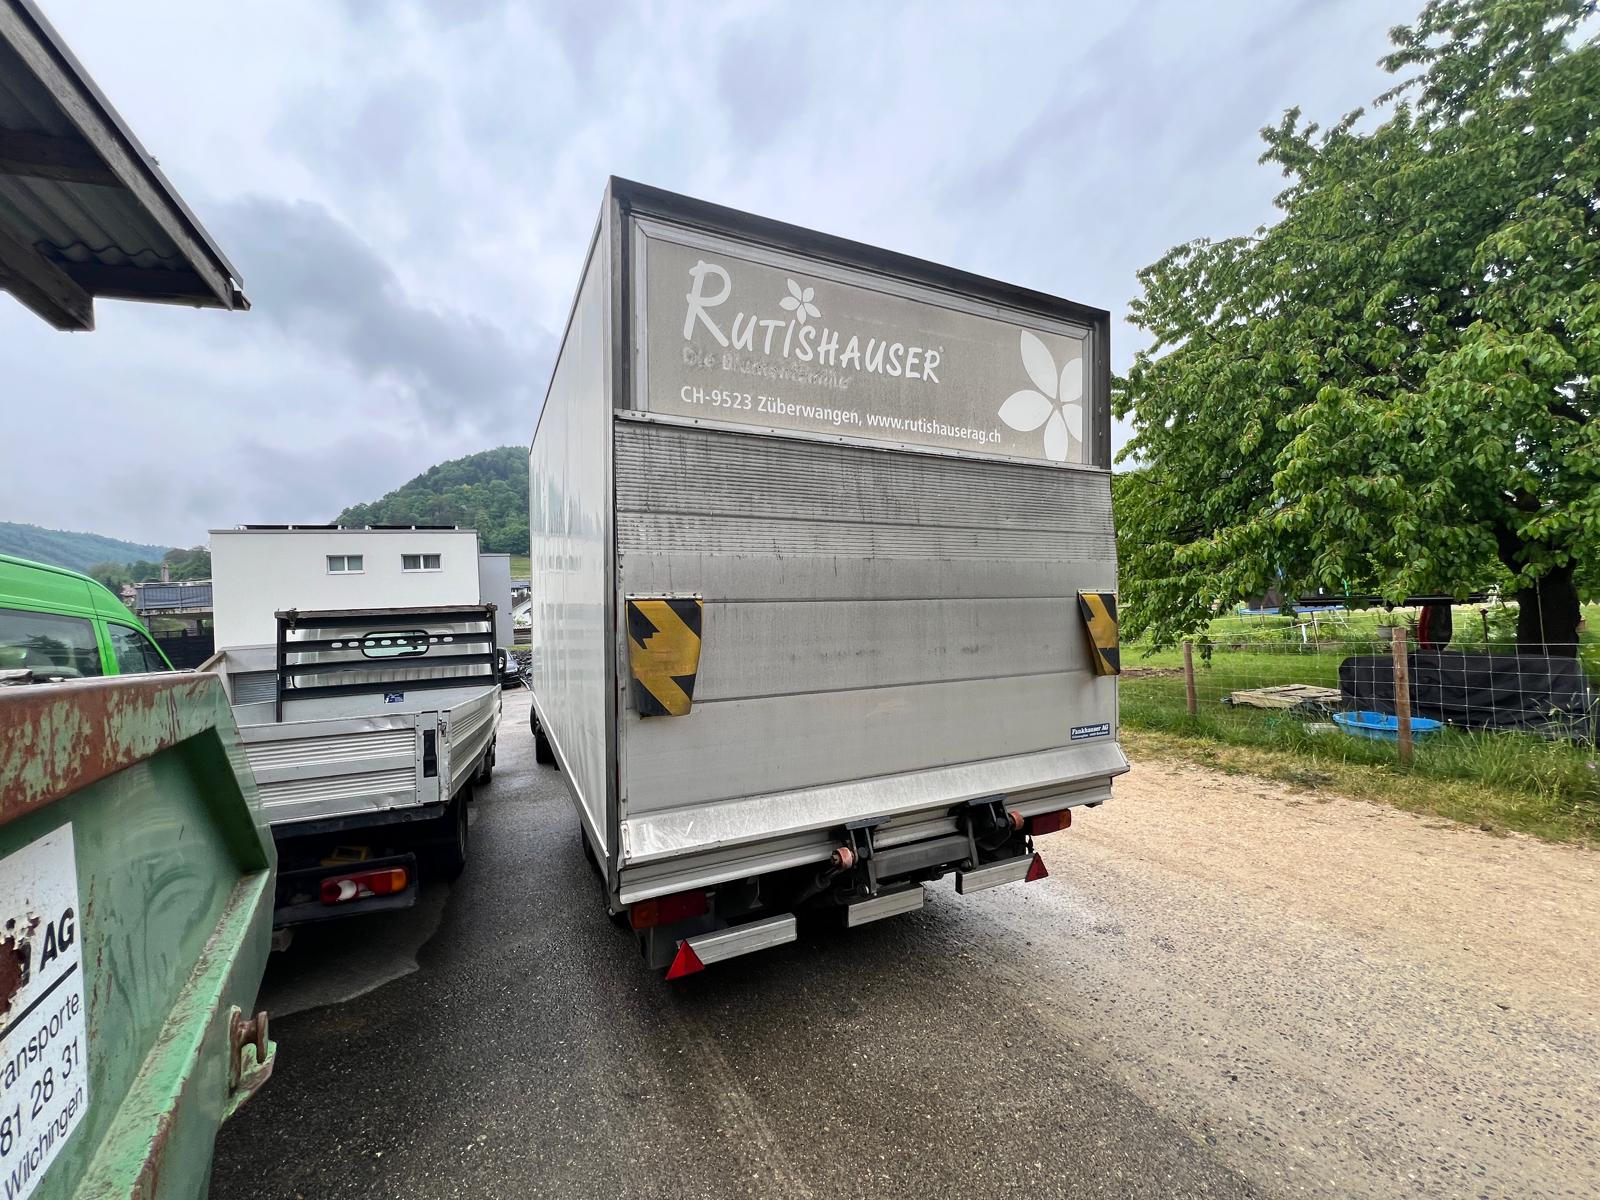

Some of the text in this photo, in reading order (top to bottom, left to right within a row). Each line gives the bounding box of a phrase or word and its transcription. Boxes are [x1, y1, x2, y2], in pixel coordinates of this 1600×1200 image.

[683, 260, 941, 384] RUTISHAUSER
[681, 385, 1001, 445] CH-9523 Züberwangen, www.rutishauserag.ch
[39, 907, 75, 973] AG
[30, 1066, 54, 1121] 28
[62, 1035, 78, 1079] 31
[5, 1087, 83, 1200] Wilchingen
